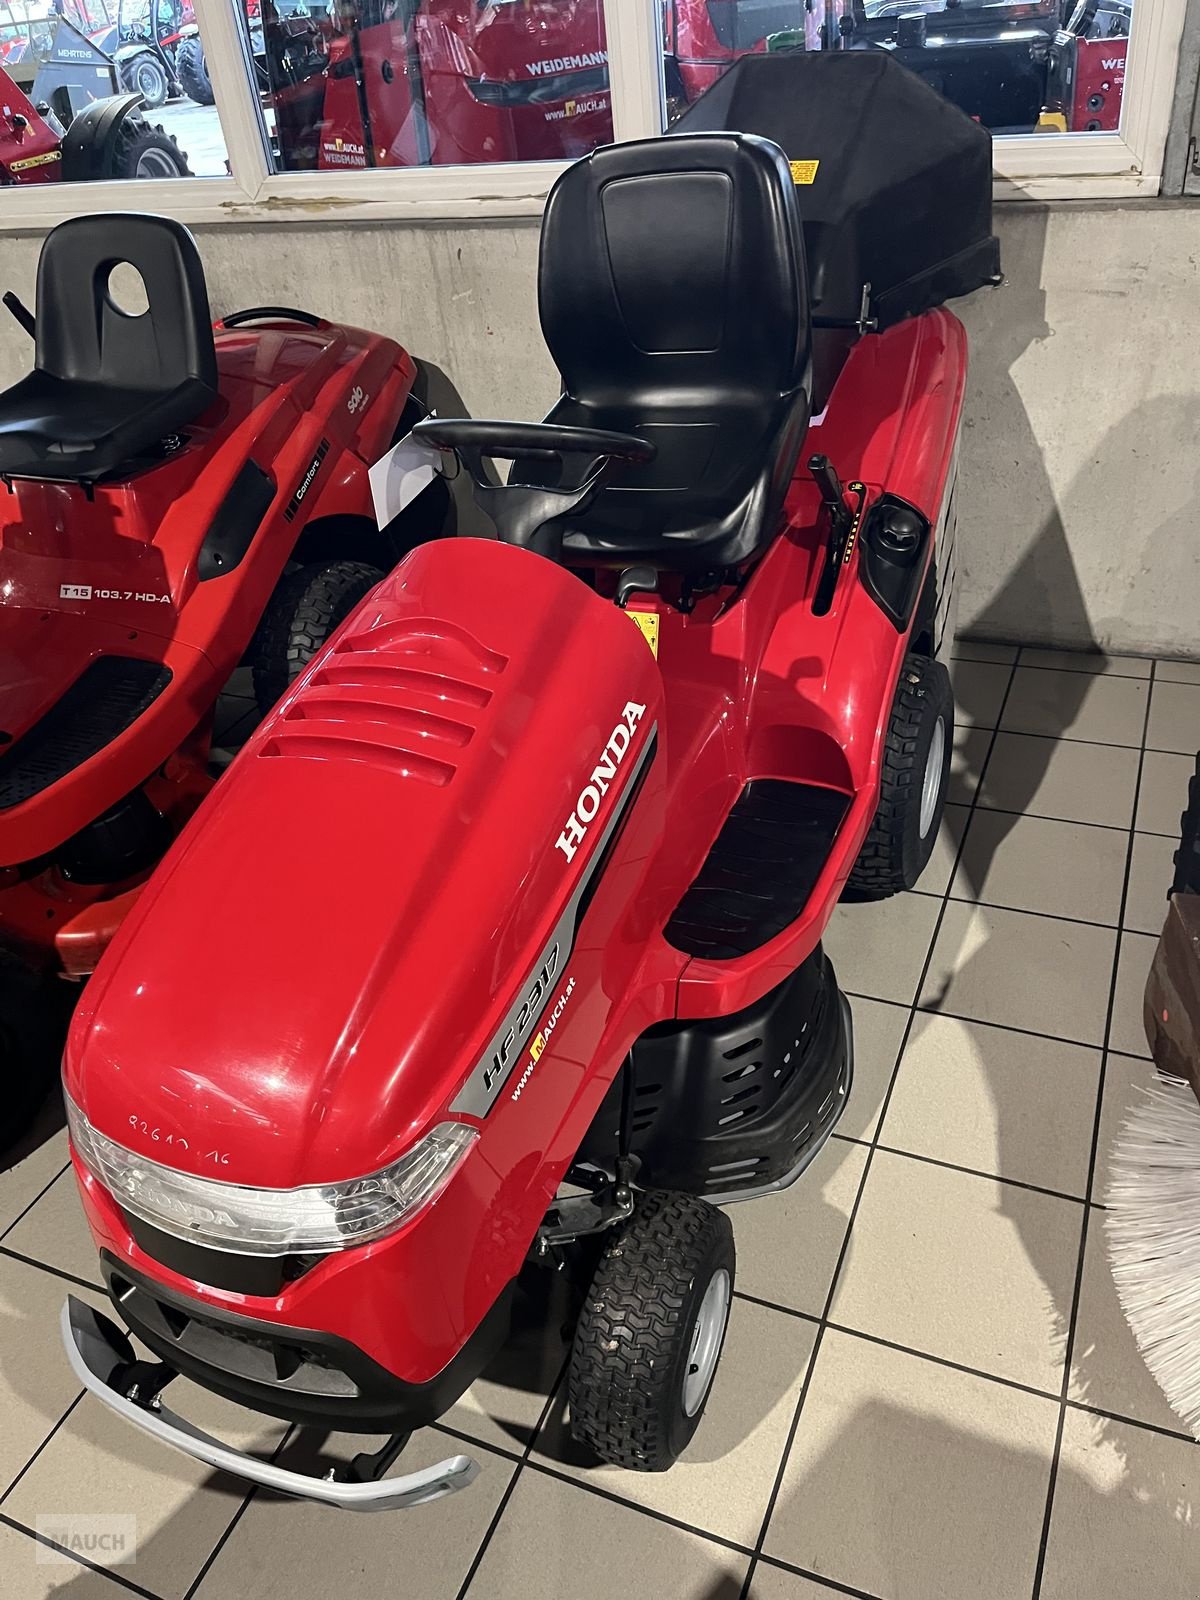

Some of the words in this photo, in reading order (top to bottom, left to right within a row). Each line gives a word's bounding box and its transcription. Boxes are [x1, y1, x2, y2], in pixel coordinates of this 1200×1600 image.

[57, 48, 92, 59] MEHRTENS
[525, 50, 609, 76] WEIDEMANN
[323, 152, 367, 167] WEIDEMANN
[347, 385, 363, 414] solo
[296, 459, 320, 500] Comfort
[94, 589, 133, 600] 103.7
[135, 592, 171, 604] HD-A
[555, 701, 647, 864] HONDA
[483, 1026, 515, 1093] HF
[516, 942, 560, 1037] 2317
[511, 977, 577, 1101] www.MAUCH.at
